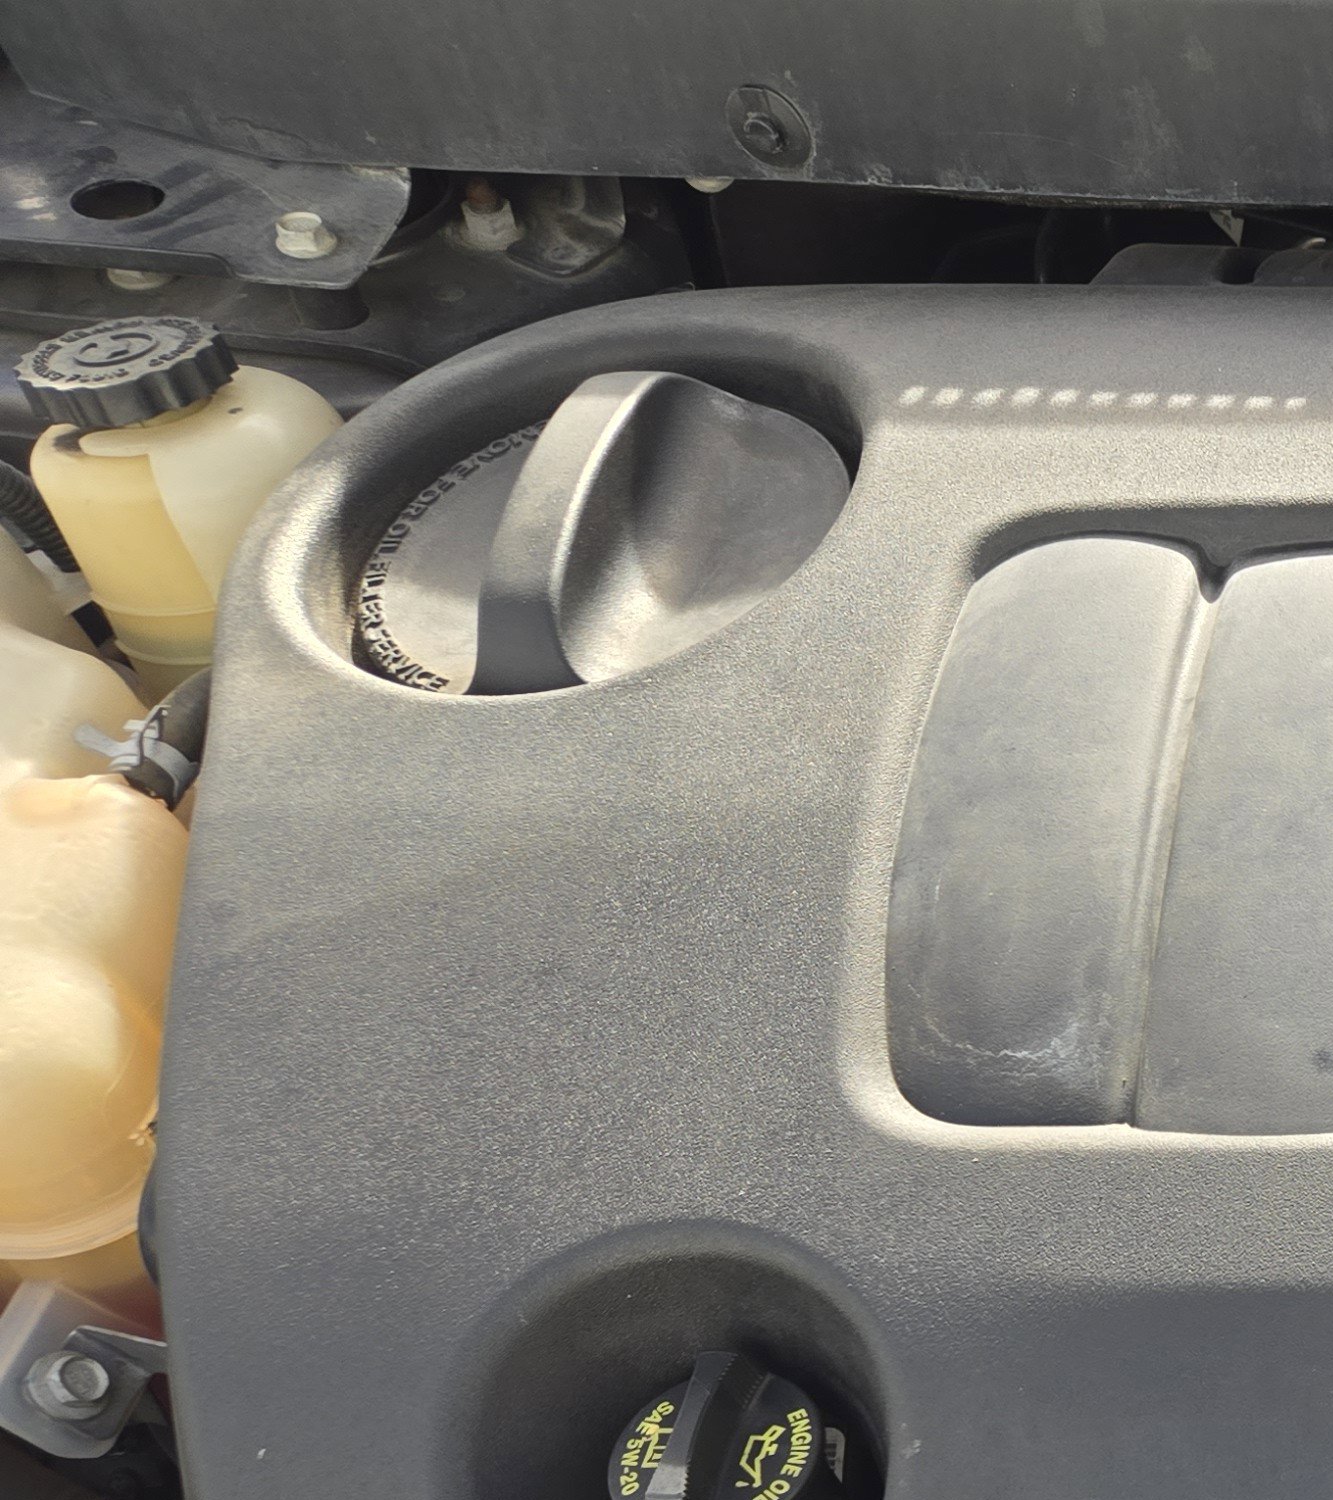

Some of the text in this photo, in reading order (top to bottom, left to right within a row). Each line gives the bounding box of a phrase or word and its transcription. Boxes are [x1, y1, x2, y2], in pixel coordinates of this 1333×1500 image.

[619, 1401, 675, 1497] SAE 5W-20
[780, 1408, 813, 1478] ENGINE
